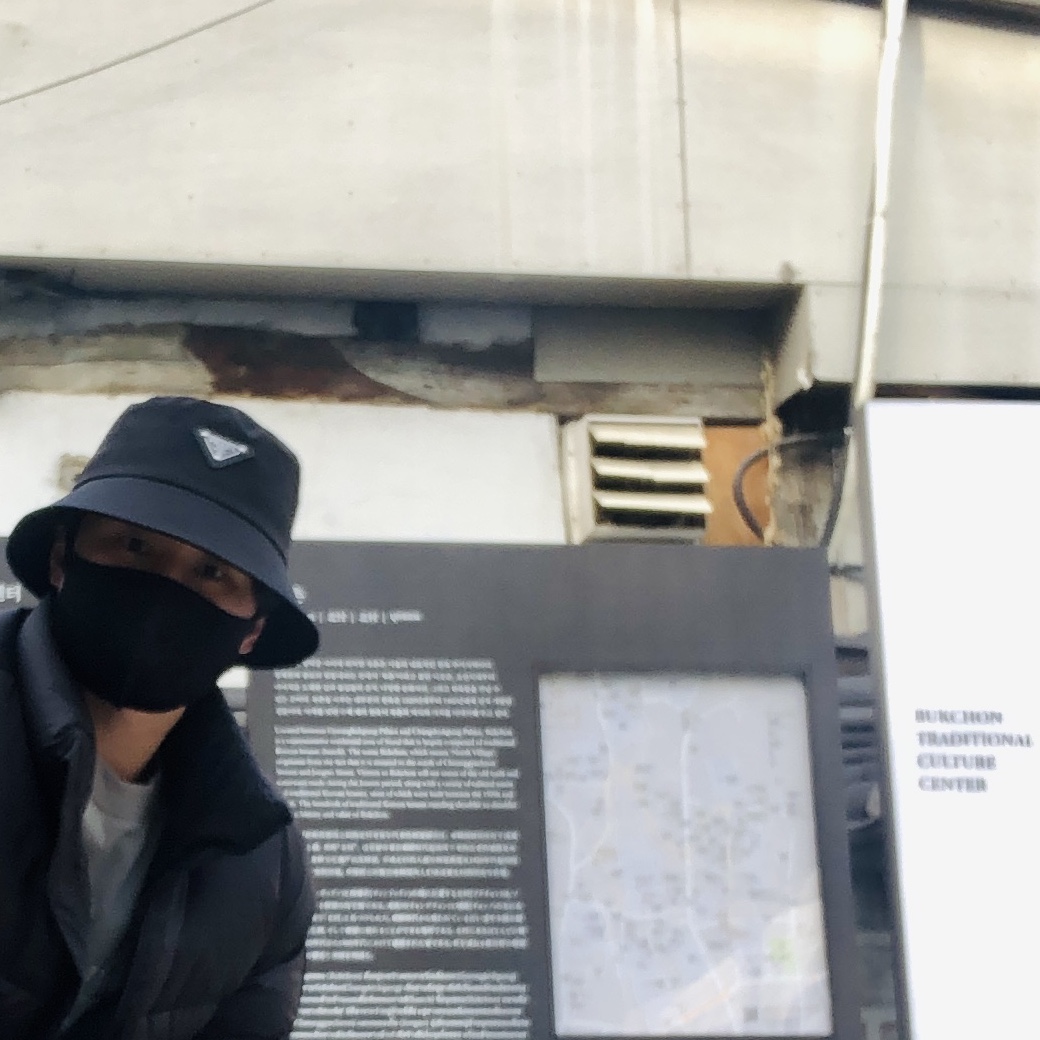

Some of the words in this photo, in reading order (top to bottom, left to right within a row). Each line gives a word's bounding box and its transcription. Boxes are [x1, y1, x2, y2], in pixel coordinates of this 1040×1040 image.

[915, 709, 1003, 724] BUKCHON
[916, 731, 1033, 747] TRADITIONAL
[917, 753, 996, 770] CULTURE
[918, 776, 987, 792] CENTER
